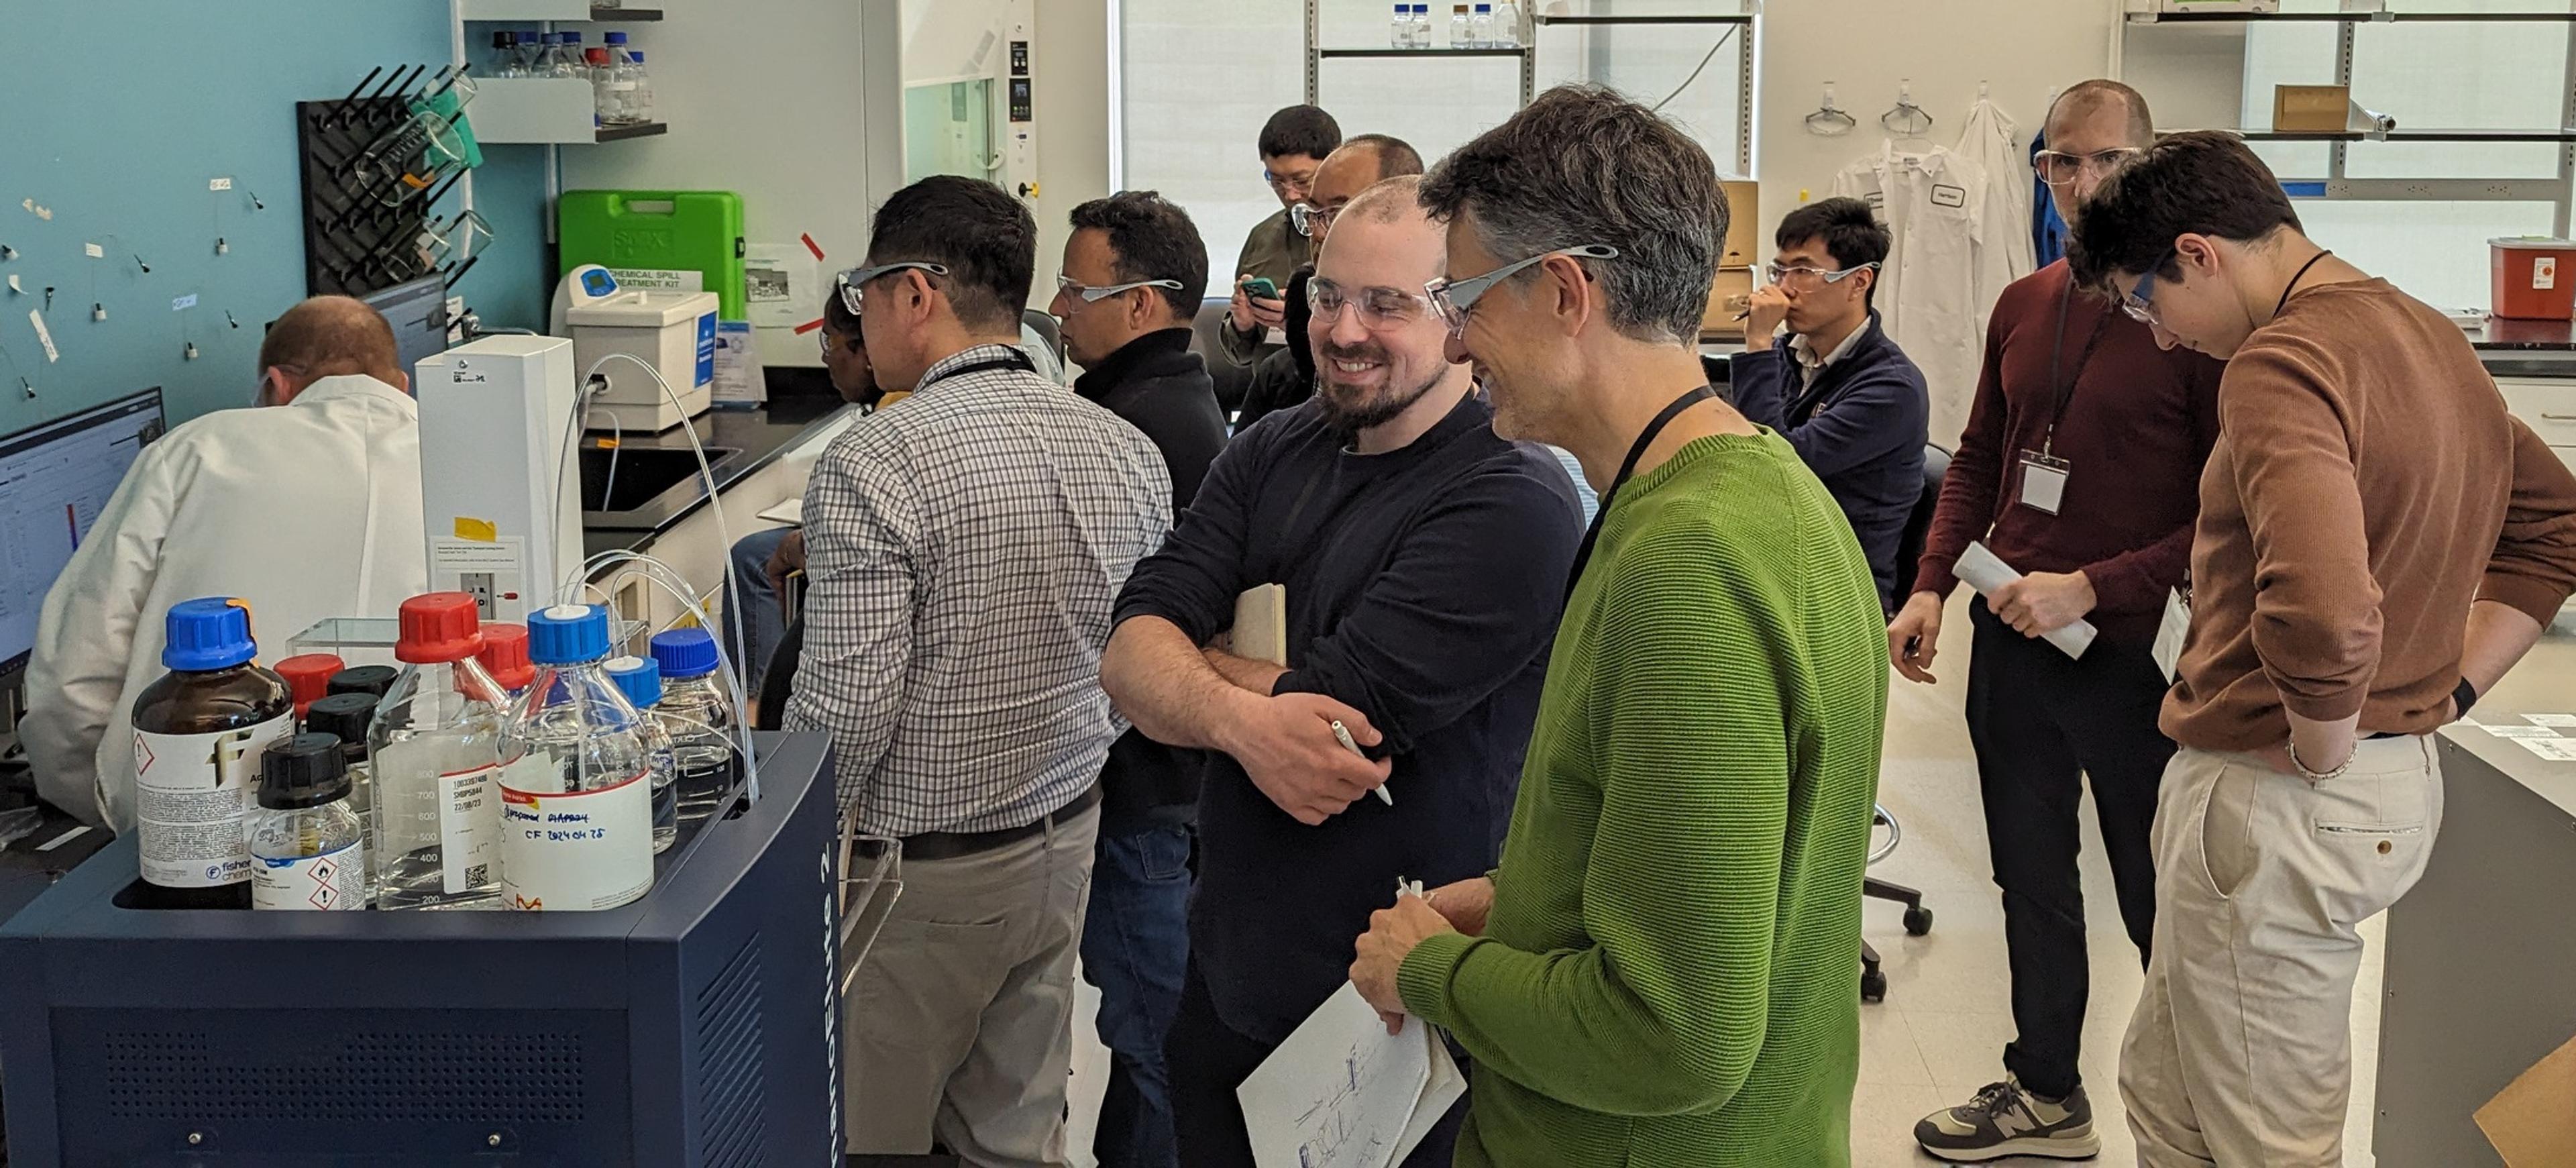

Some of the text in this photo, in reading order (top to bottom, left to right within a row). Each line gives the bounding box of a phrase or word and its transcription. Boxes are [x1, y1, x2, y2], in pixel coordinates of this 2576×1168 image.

[610, 270, 681, 280] CHEMICAL SPILL
[615, 279, 661, 287] REATMENT
[418, 792, 435, 800] 700
[419, 833, 437, 841] 500
[420, 853, 438, 862] 400
[222, 859, 252, 871] fisher
[422, 896, 440, 904] 200
